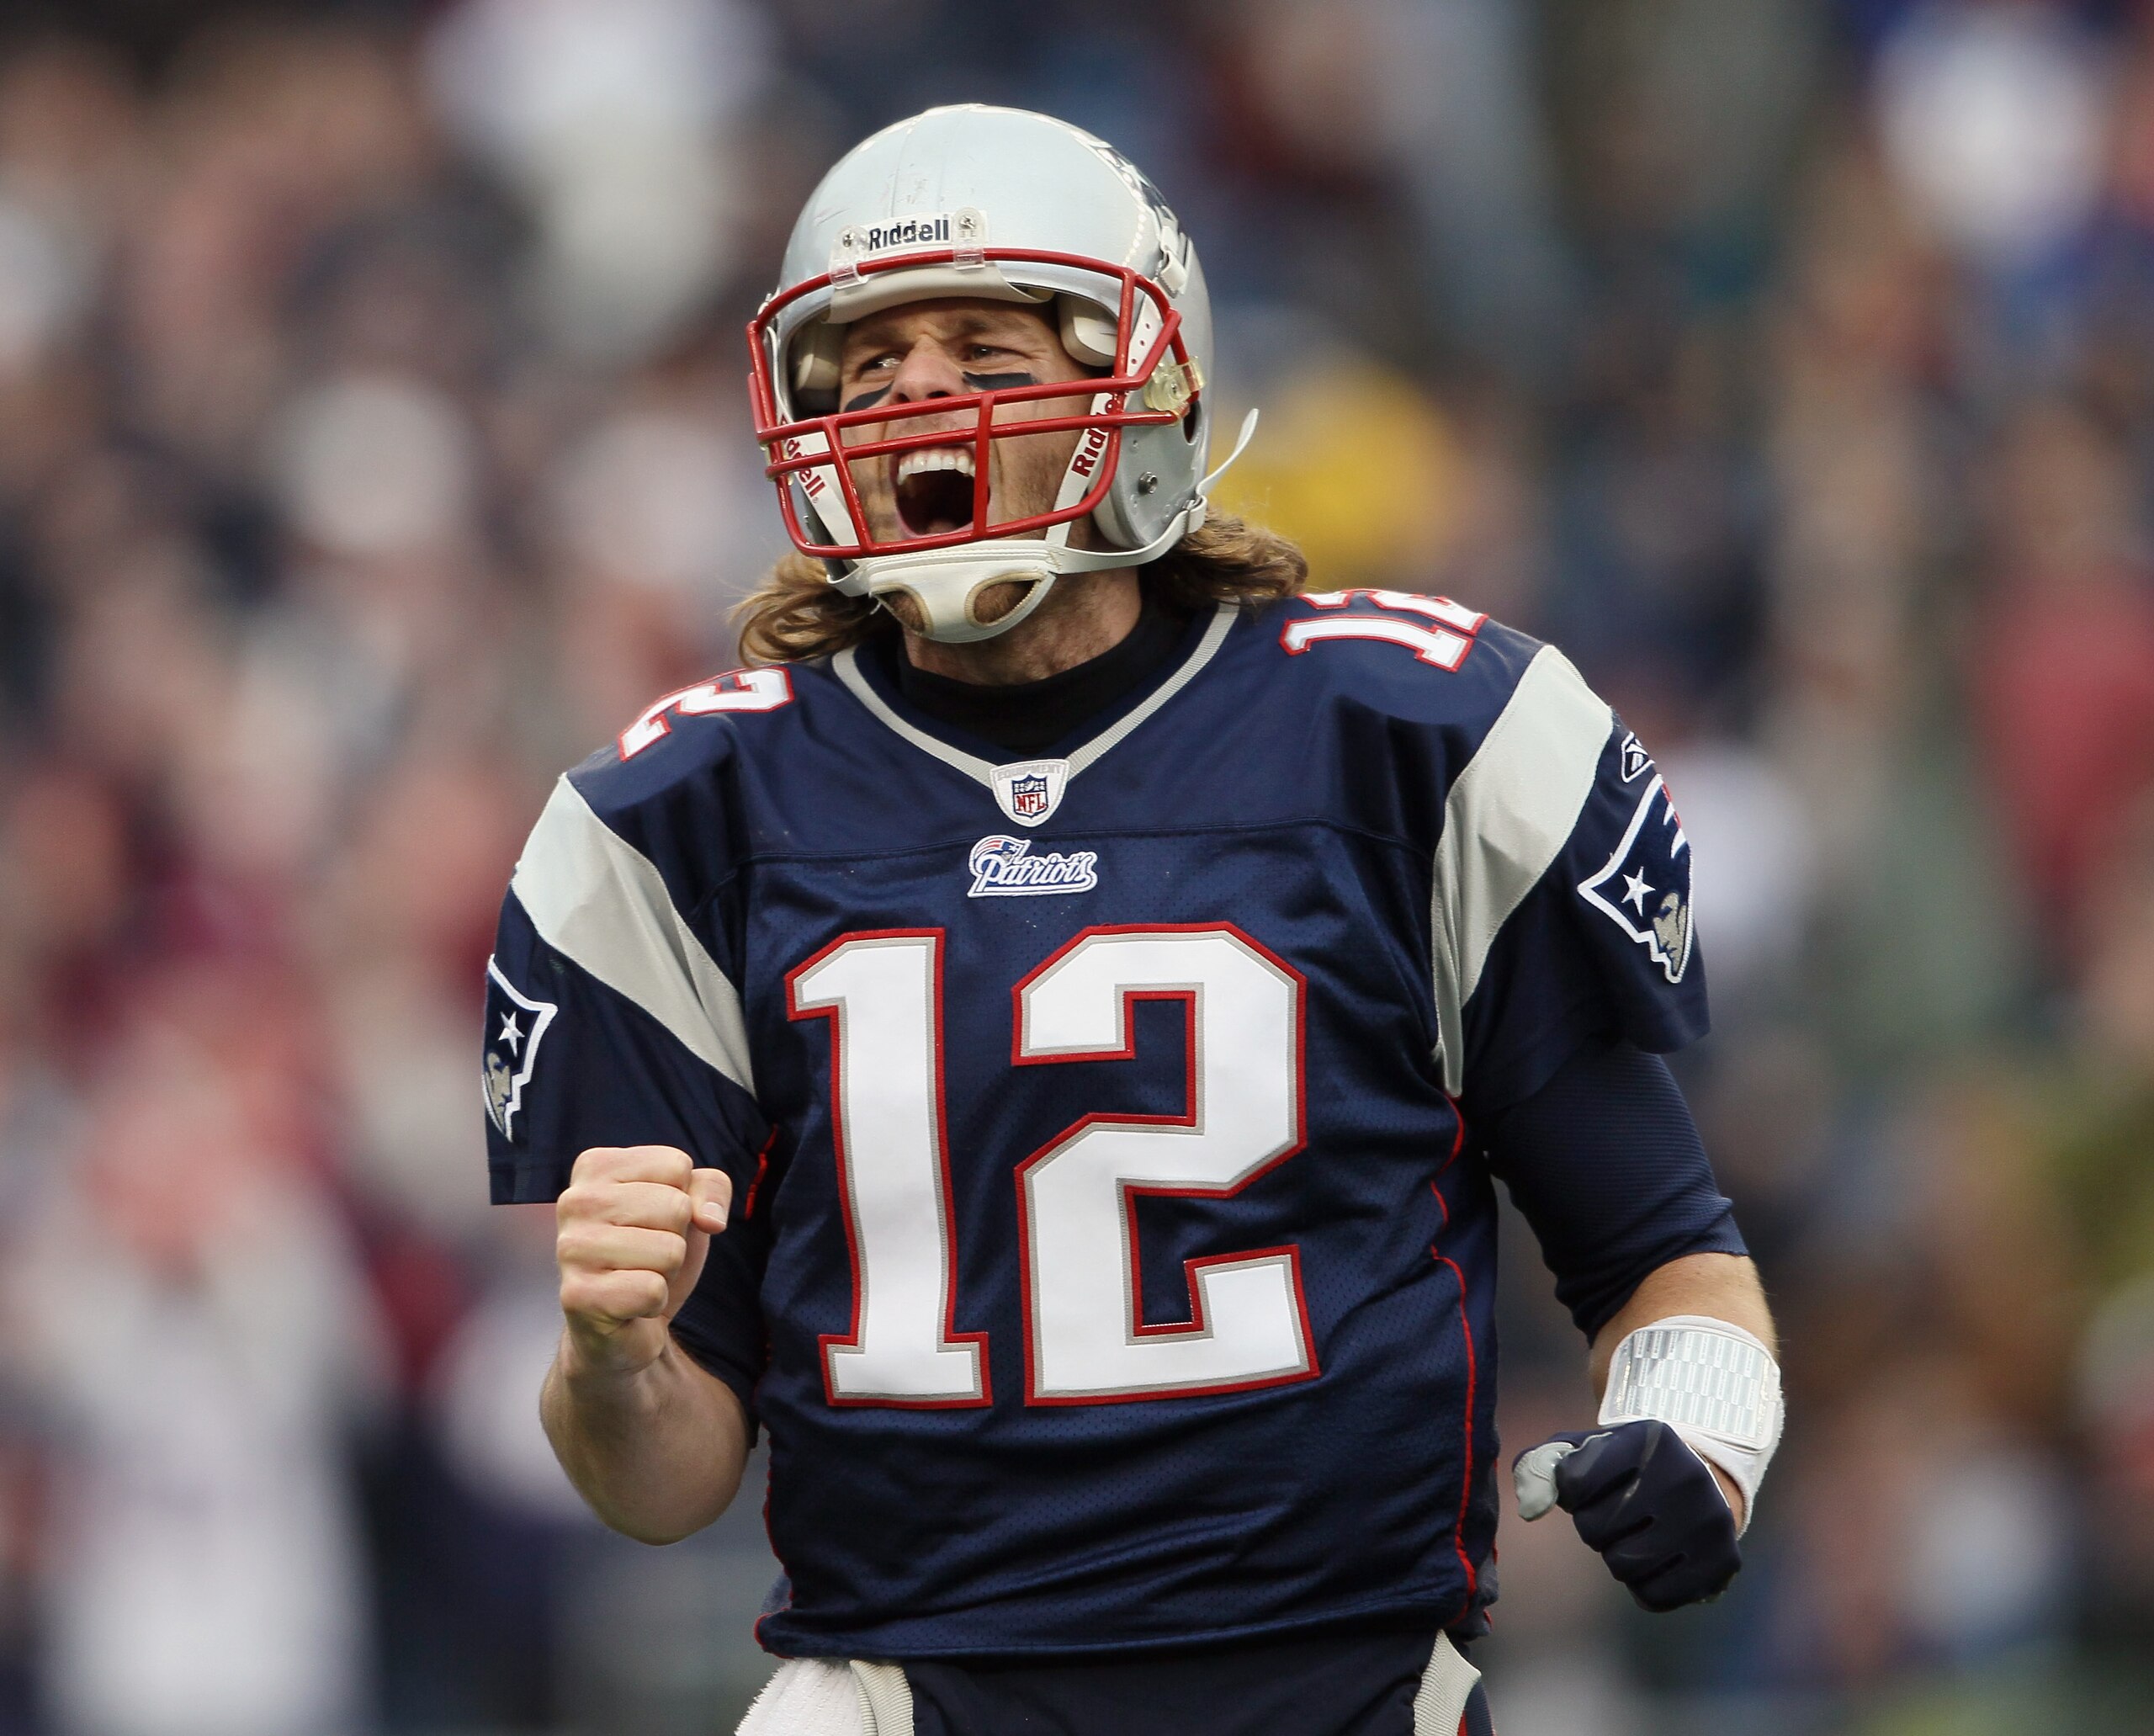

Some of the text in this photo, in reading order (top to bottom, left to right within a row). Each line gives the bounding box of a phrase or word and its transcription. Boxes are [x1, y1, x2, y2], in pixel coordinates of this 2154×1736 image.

[869, 219, 949, 251] Riddell
[782, 416, 826, 497] dell
[1071, 397, 1117, 478] Ride
[1015, 793, 1047, 814] NFL
[970, 849, 1097, 895] Patriots
[784, 921, 1320, 1409] 12
